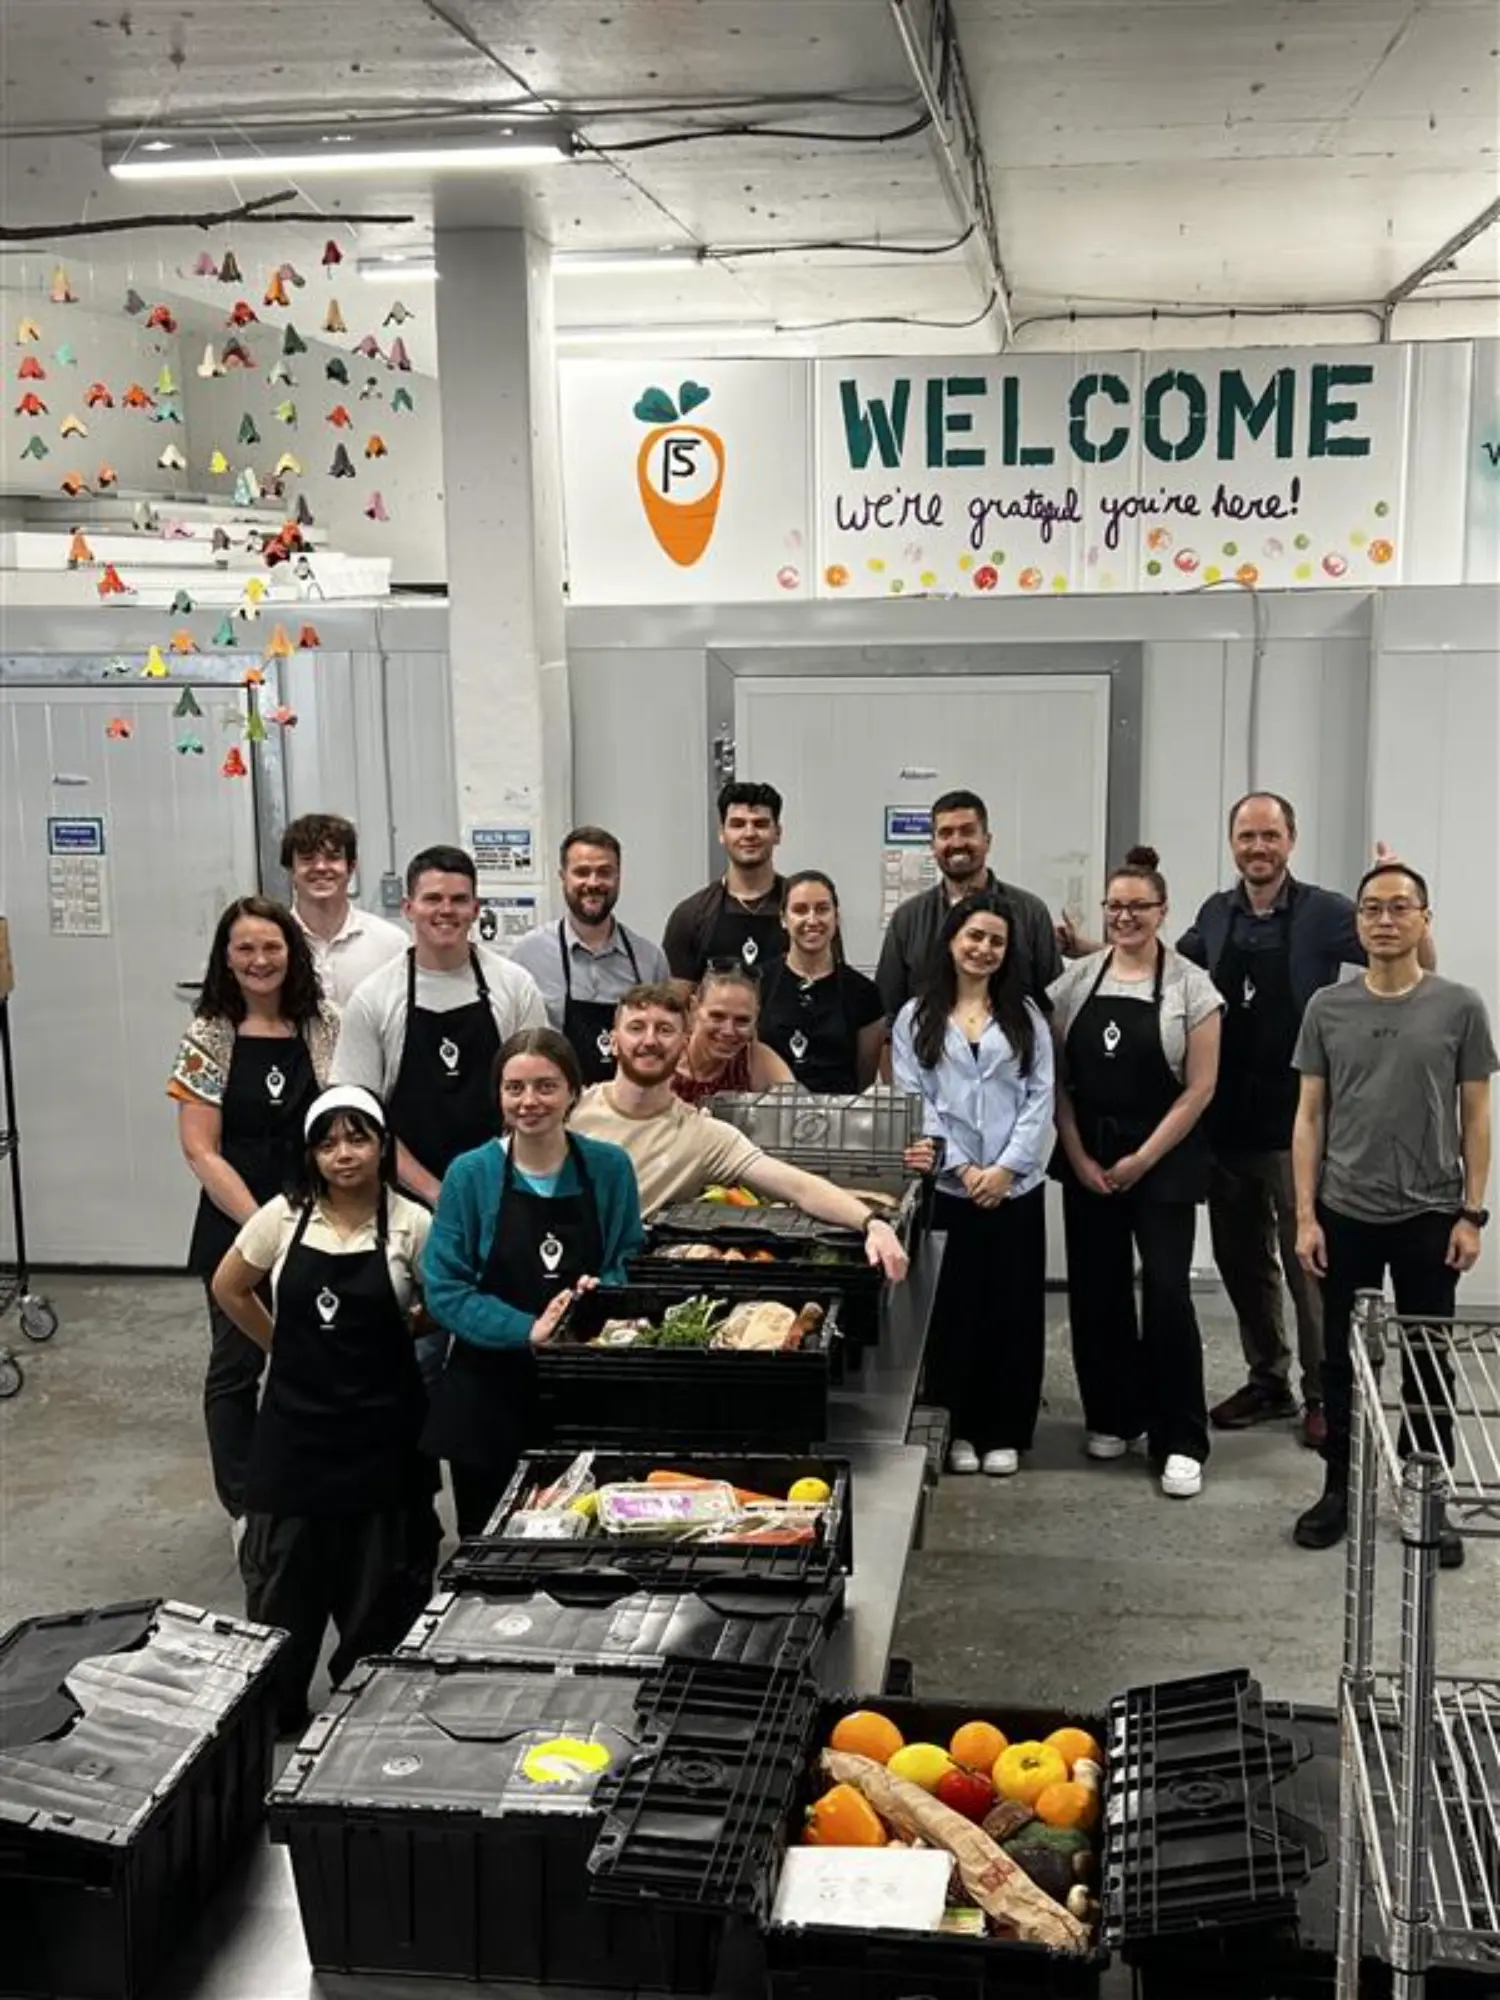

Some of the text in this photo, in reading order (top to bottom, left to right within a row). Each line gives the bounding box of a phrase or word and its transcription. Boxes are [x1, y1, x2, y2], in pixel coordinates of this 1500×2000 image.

[840, 363, 1374, 469] WELCOME
[1099, 486, 1202, 551] you're
[1211, 475, 1301, 521] here!
